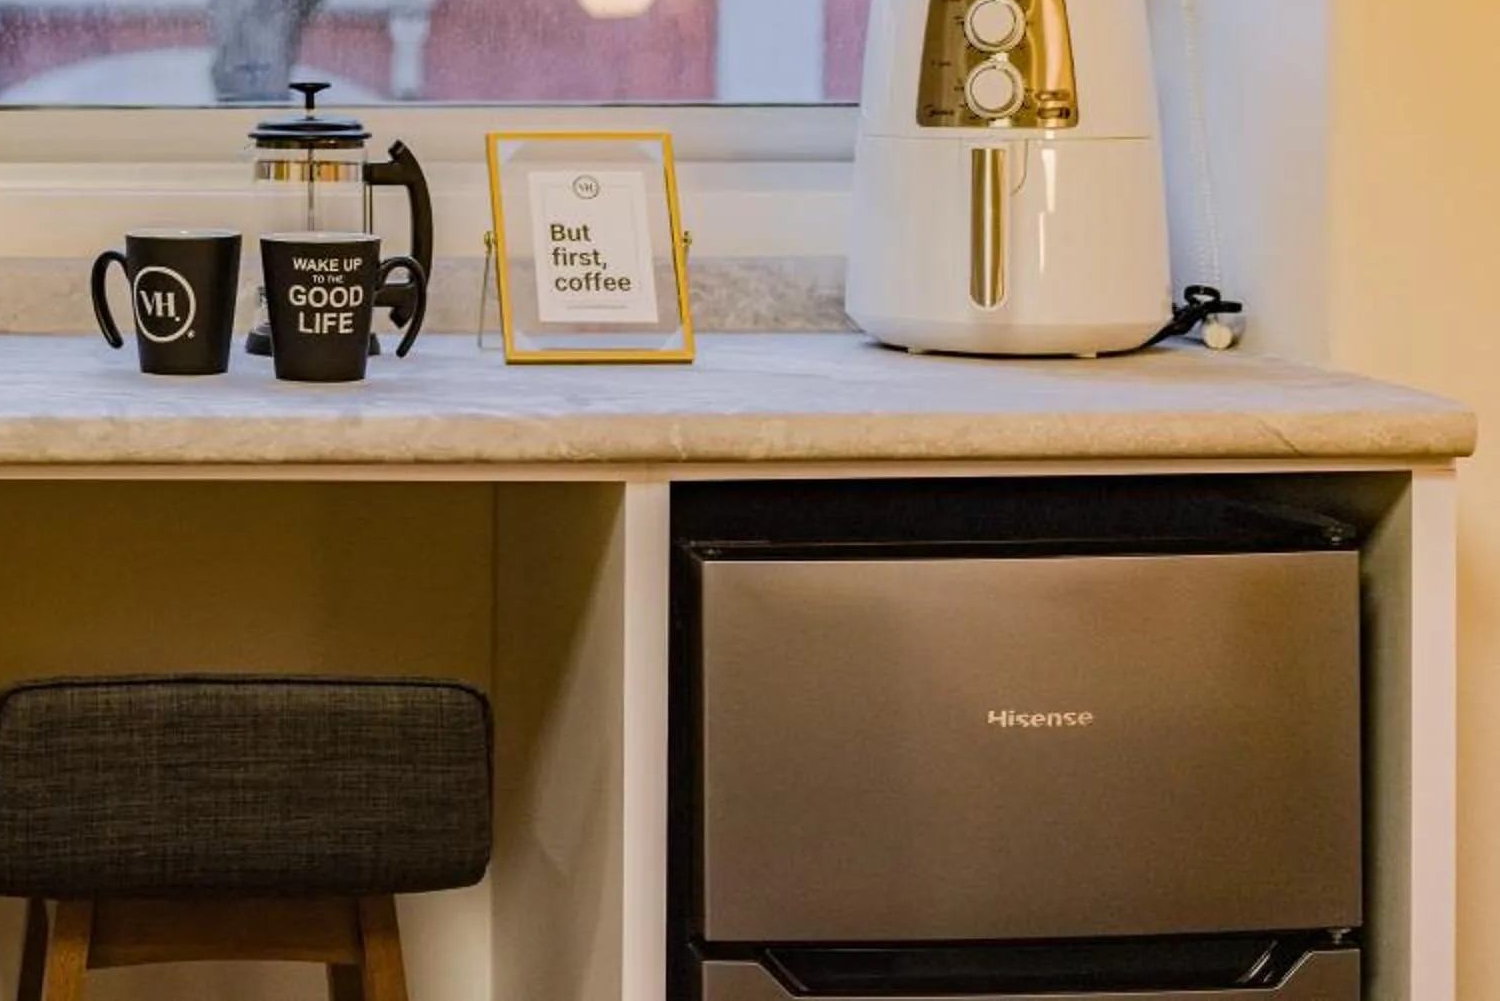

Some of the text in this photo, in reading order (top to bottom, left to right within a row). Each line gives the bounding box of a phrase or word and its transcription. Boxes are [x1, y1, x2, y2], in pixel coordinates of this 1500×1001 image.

[550, 224, 592, 242] But
[292, 256, 363, 272] WAKE UP
[552, 247, 607, 270] first,
[312, 274, 325, 284] TO
[555, 273, 631, 291] coffee
[289, 284, 364, 308] GOOD
[298, 311, 354, 334] LIFE
[987, 710, 1093, 728] Hisense
